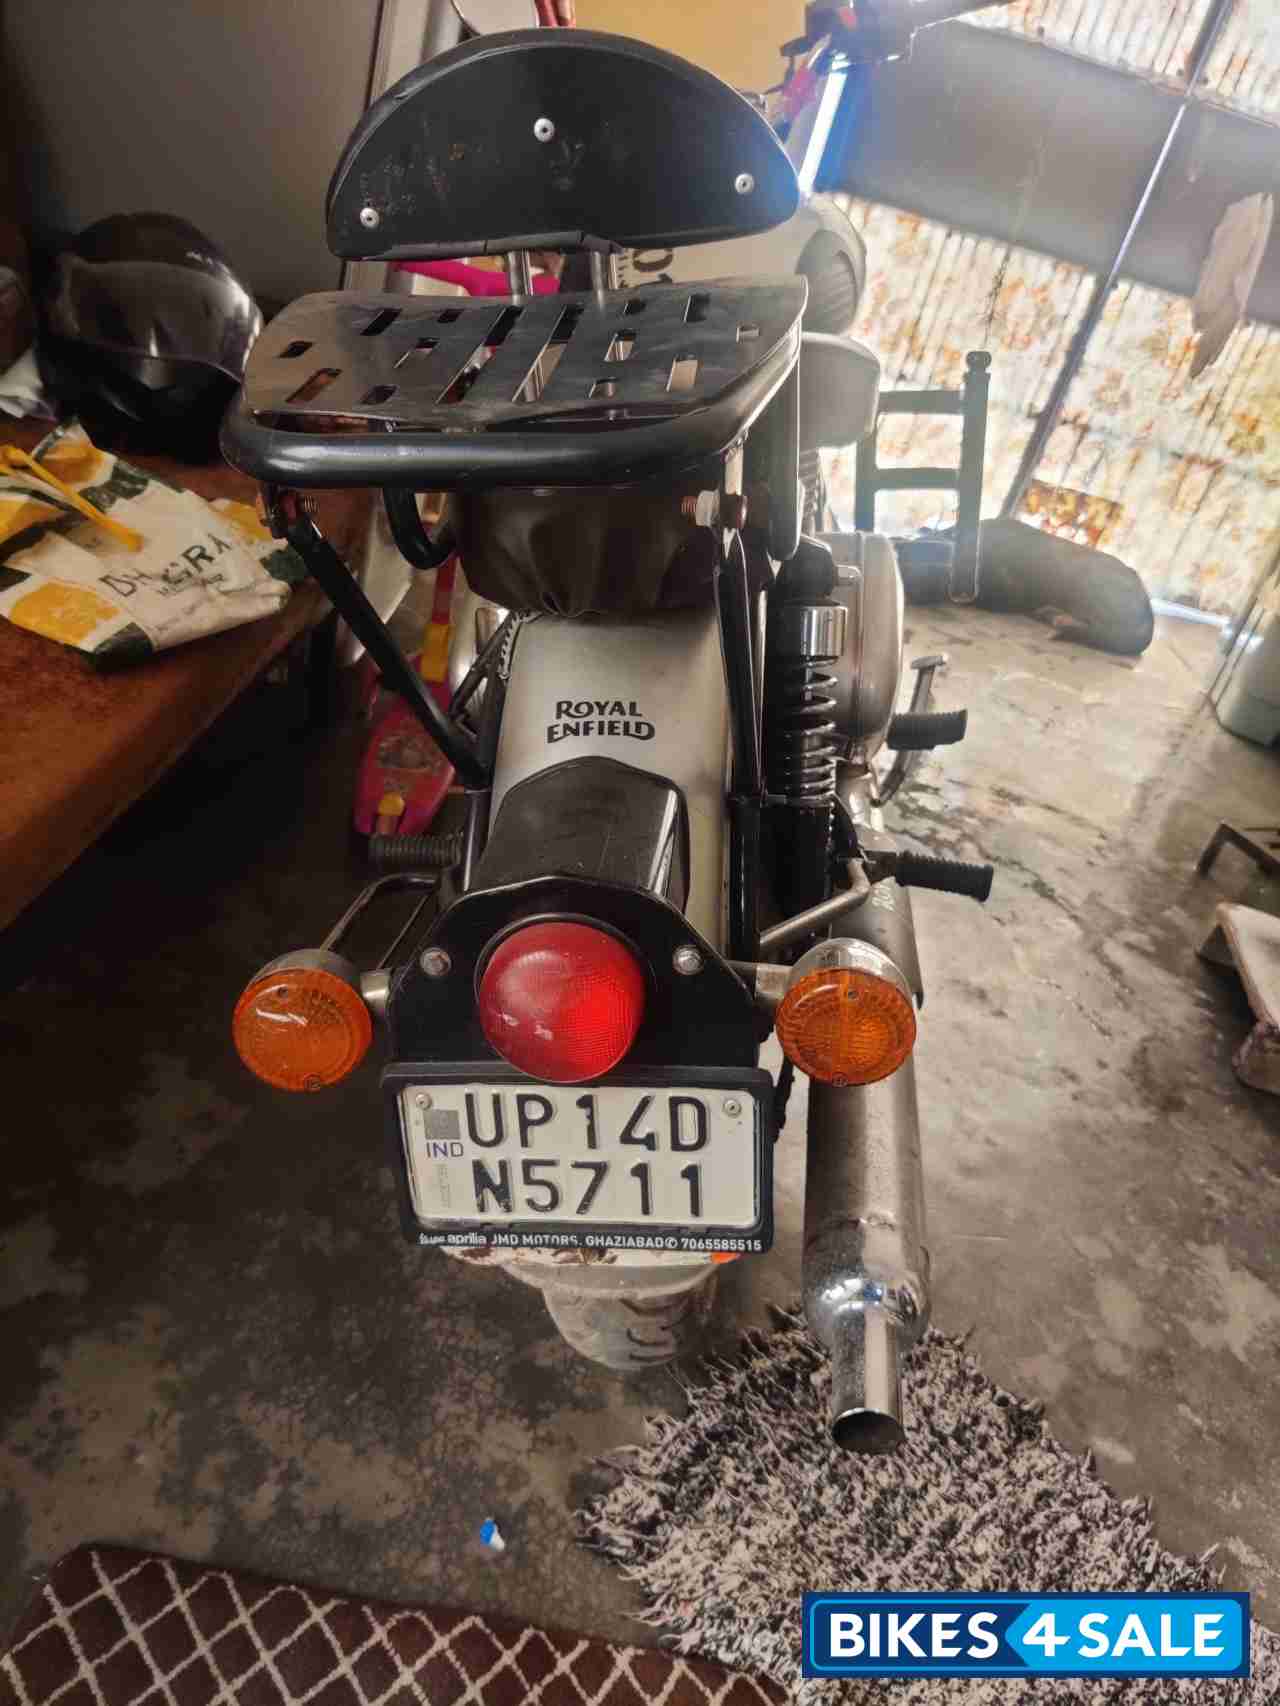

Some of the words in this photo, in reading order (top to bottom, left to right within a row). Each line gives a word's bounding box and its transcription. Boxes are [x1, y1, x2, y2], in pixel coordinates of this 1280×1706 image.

[555, 700, 643, 719] ROYAL
[547, 720, 655, 744] ENFIELD
[426, 1142, 464, 1158] IND
[472, 1159, 704, 1217] N5711
[447, 1232, 487, 1245] aprilia
[491, 1233, 519, 1245] JMD
[681, 1238, 762, 1251] 7065585515
